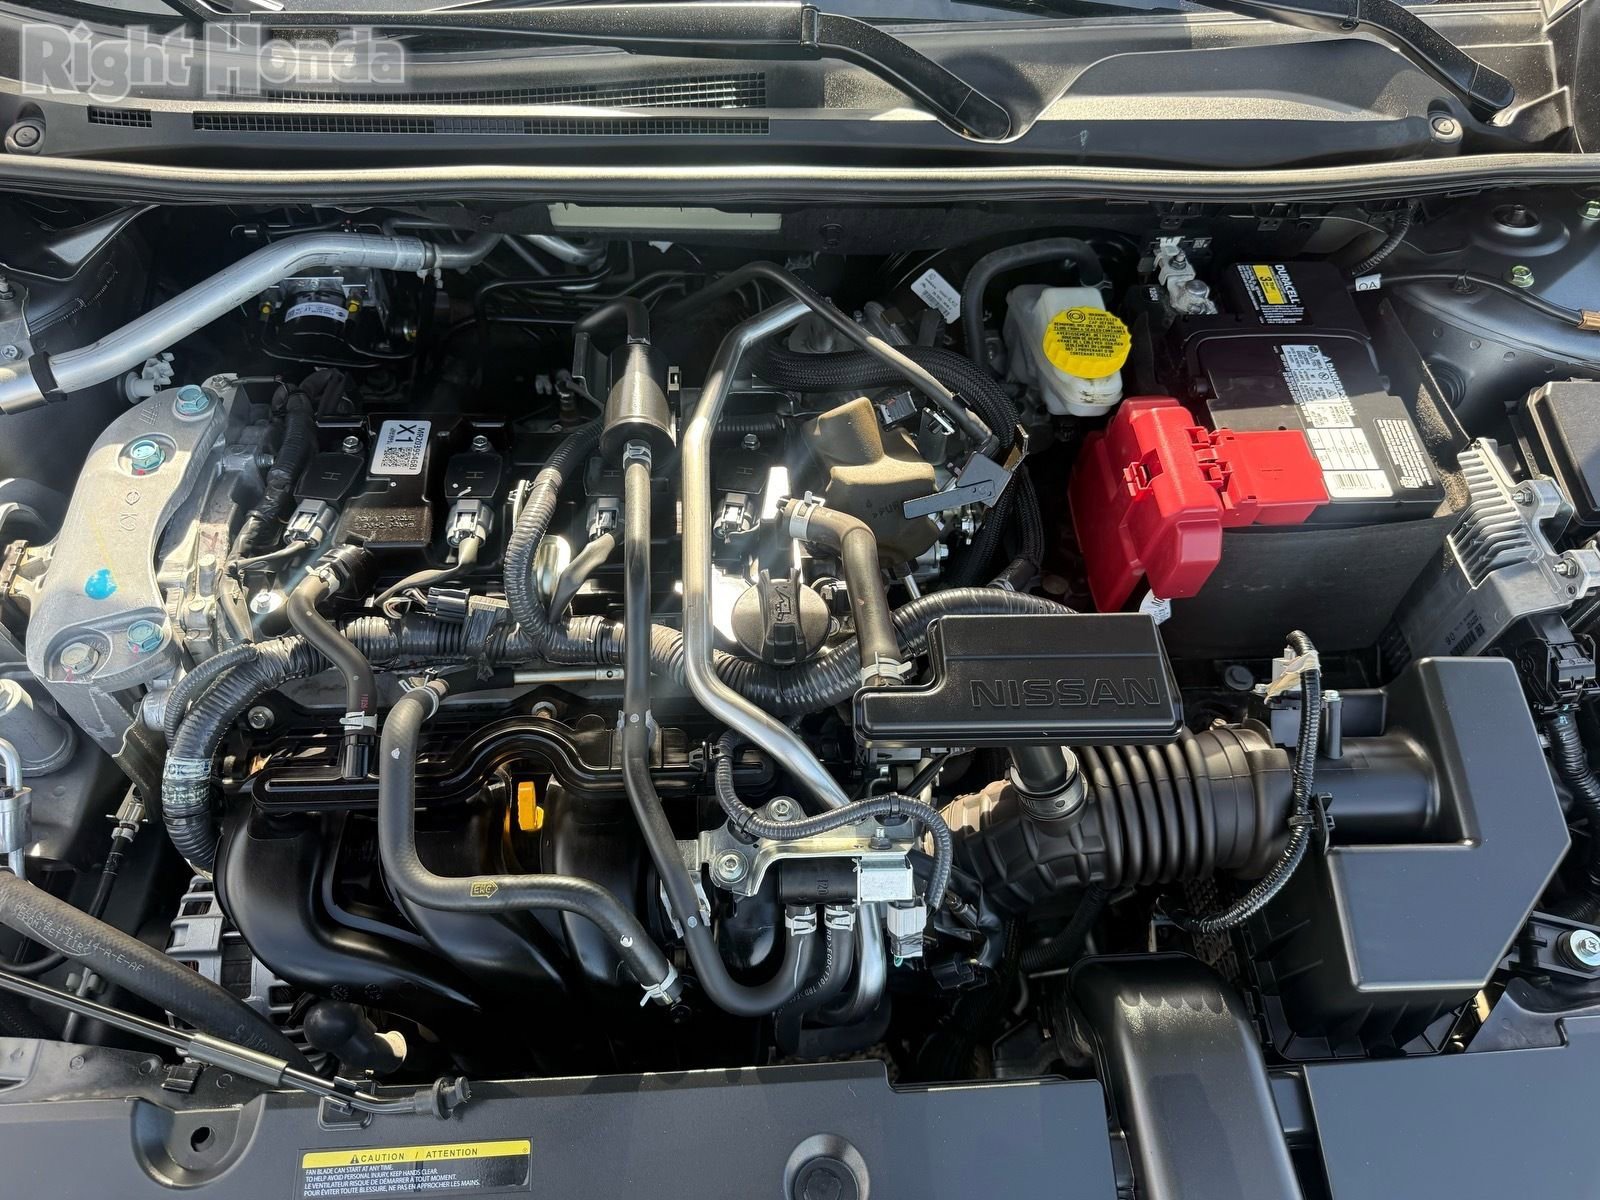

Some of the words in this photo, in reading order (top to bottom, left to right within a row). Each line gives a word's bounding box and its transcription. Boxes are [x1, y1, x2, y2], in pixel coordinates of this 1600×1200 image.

[1274, 264, 1301, 304] DURACELL
[395, 423, 417, 442] X1
[970, 678, 1161, 707] NISSAN
[361, 1152, 405, 1163] CAUTION
[426, 1148, 478, 1158] ATTENTION
[312, 1181, 349, 1189] VENTILATEUR
[379, 1176, 409, 1184] DÉMARRER
[344, 1172, 370, 1180] PERSONAL
[321, 1188, 340, 1196] ÉVITER
